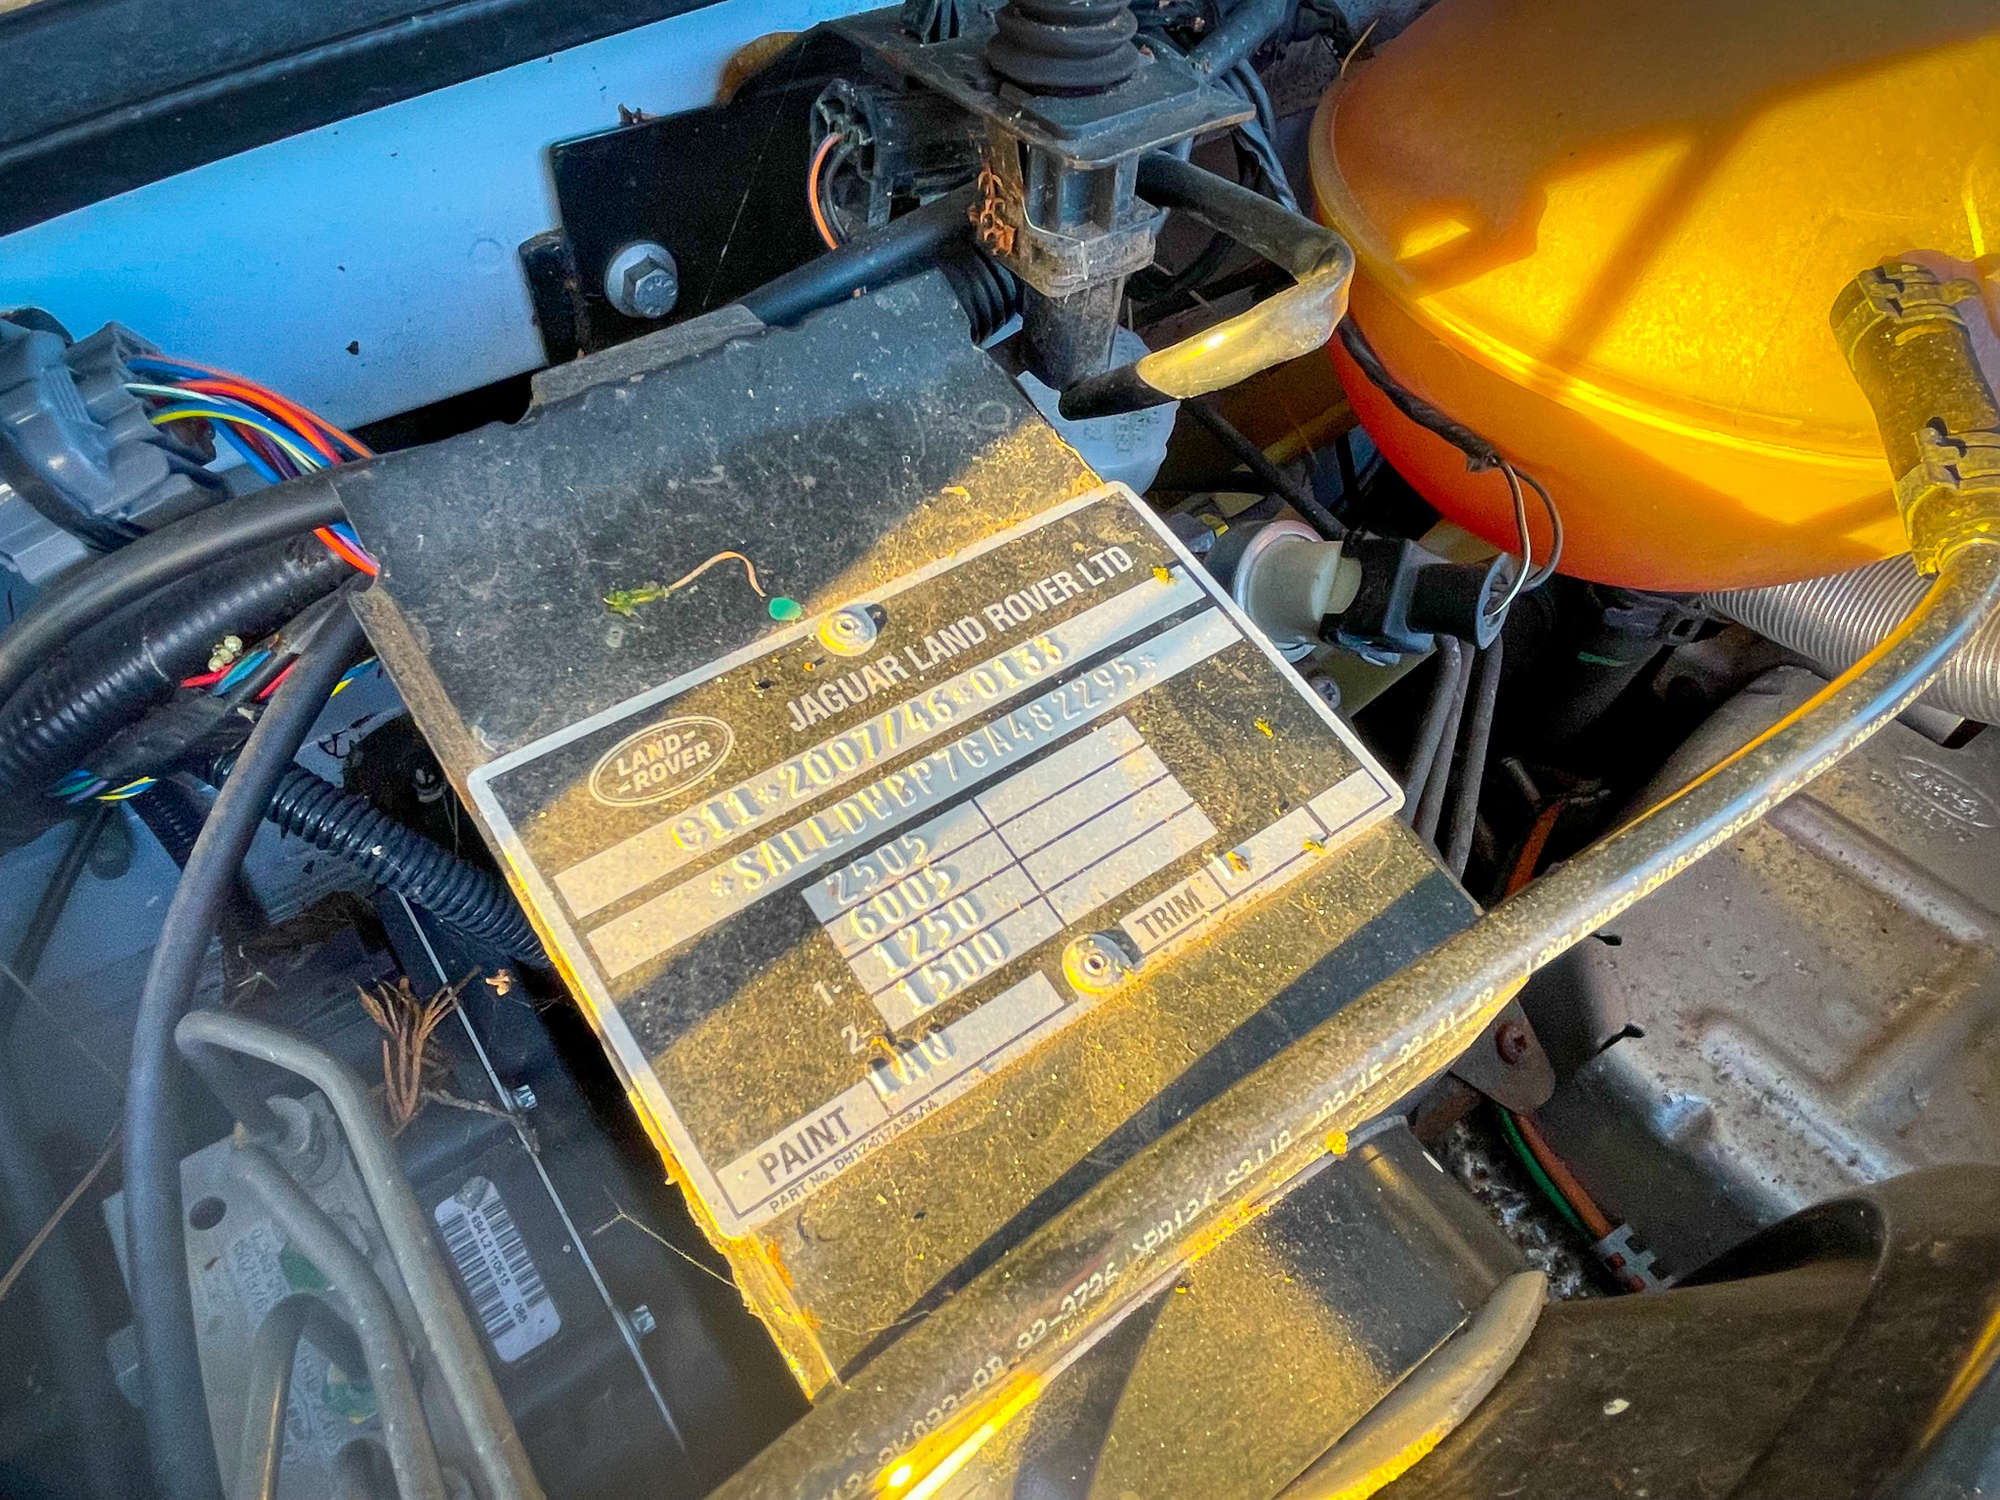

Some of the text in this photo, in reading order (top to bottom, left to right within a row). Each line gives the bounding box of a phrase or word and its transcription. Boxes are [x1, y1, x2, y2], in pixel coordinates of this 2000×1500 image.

[788, 545, 1134, 732] JAGUAR LAND ROVER LTD
[826, 835, 928, 905] 2505
[850, 866, 952, 940] 6005
[872, 895, 979, 978] 1250
[1136, 889, 1205, 942] TRIM
[896, 929, 1005, 1016] 1500
[758, 1106, 853, 1185] PAINT
[769, 1182, 808, 1213] PART
